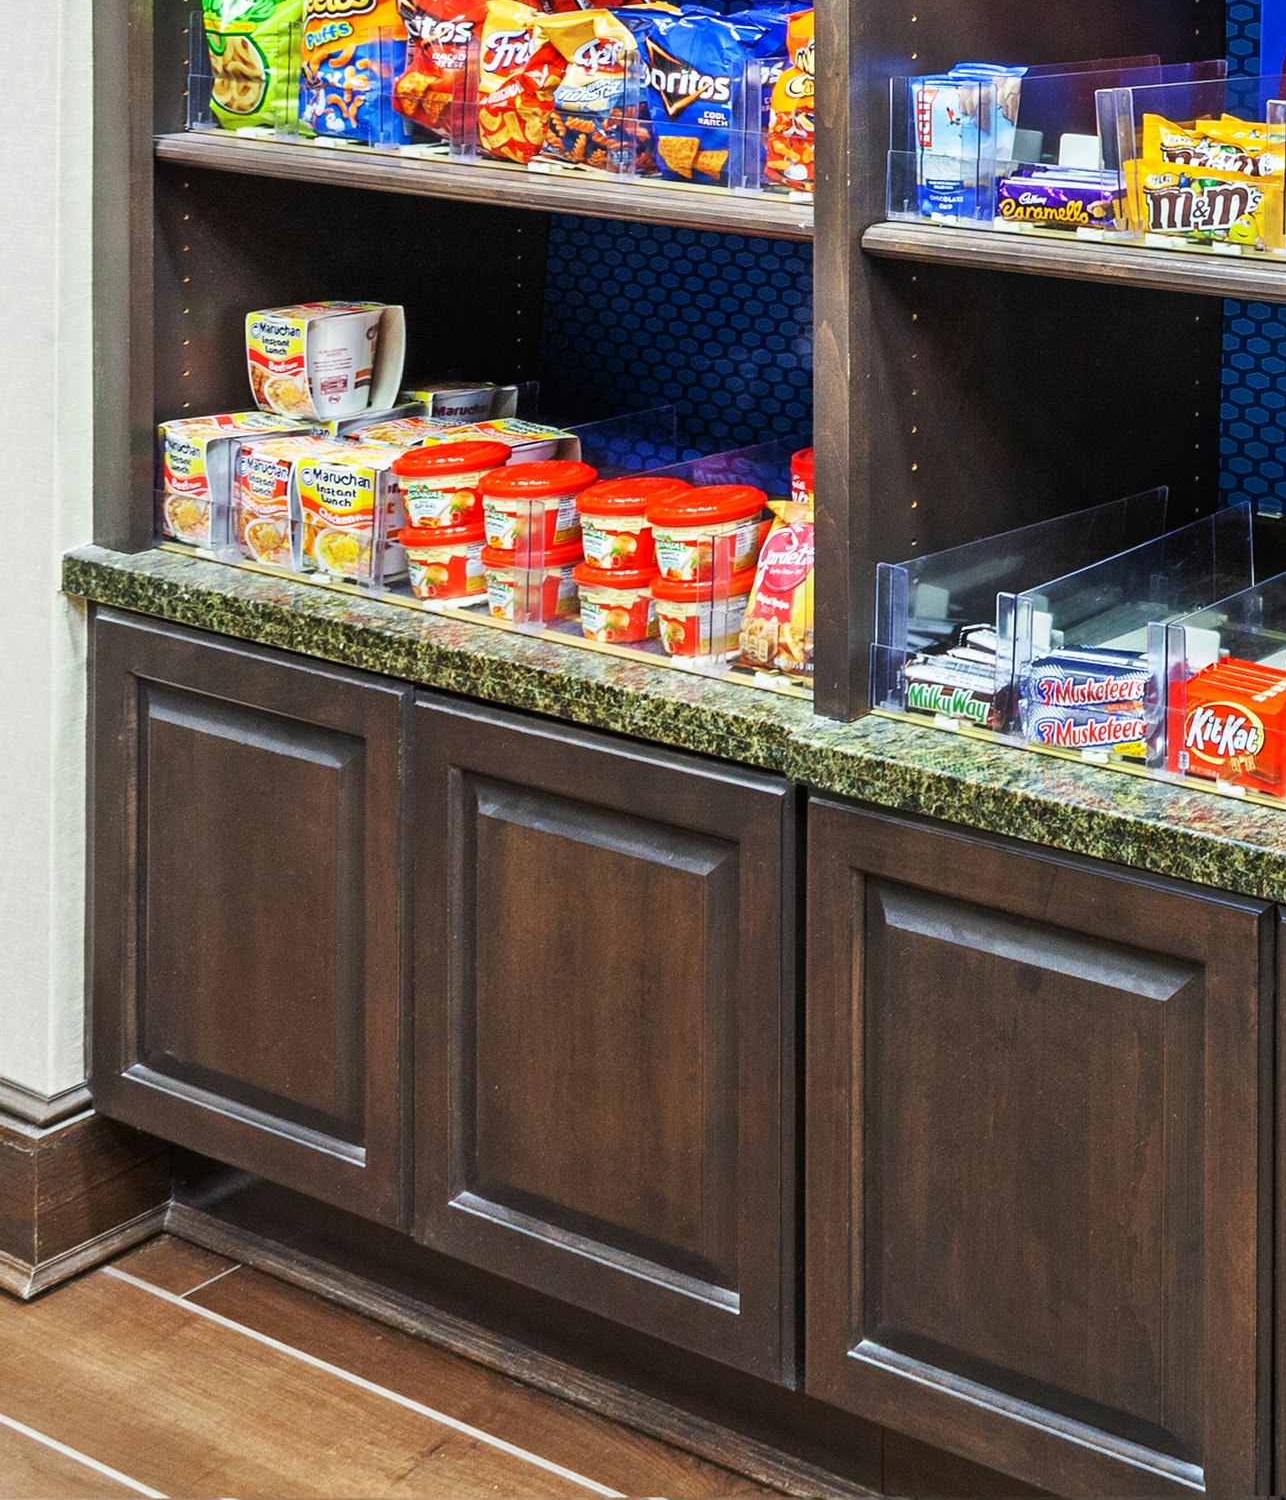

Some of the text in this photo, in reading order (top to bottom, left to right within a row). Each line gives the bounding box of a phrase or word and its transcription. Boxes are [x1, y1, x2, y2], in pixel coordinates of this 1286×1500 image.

[640, 66, 731, 102] Doritos
[697, 117, 728, 127] RANCH
[703, 111, 727, 121] COOL
[1000, 198, 1089, 224] Caramello
[260, 322, 301, 338] Maruchan
[312, 467, 372, 490] Maruchan
[316, 484, 357, 499] Instant
[321, 494, 352, 508] Lunch
[318, 506, 355, 525] Chicken
[1038, 676, 1145, 706] 3 Musketeers
[909, 683, 989, 724] Milky Way
[1037, 716, 1147, 746] 3 Musketeers
[1185, 707, 1261, 756] Kit Kat
